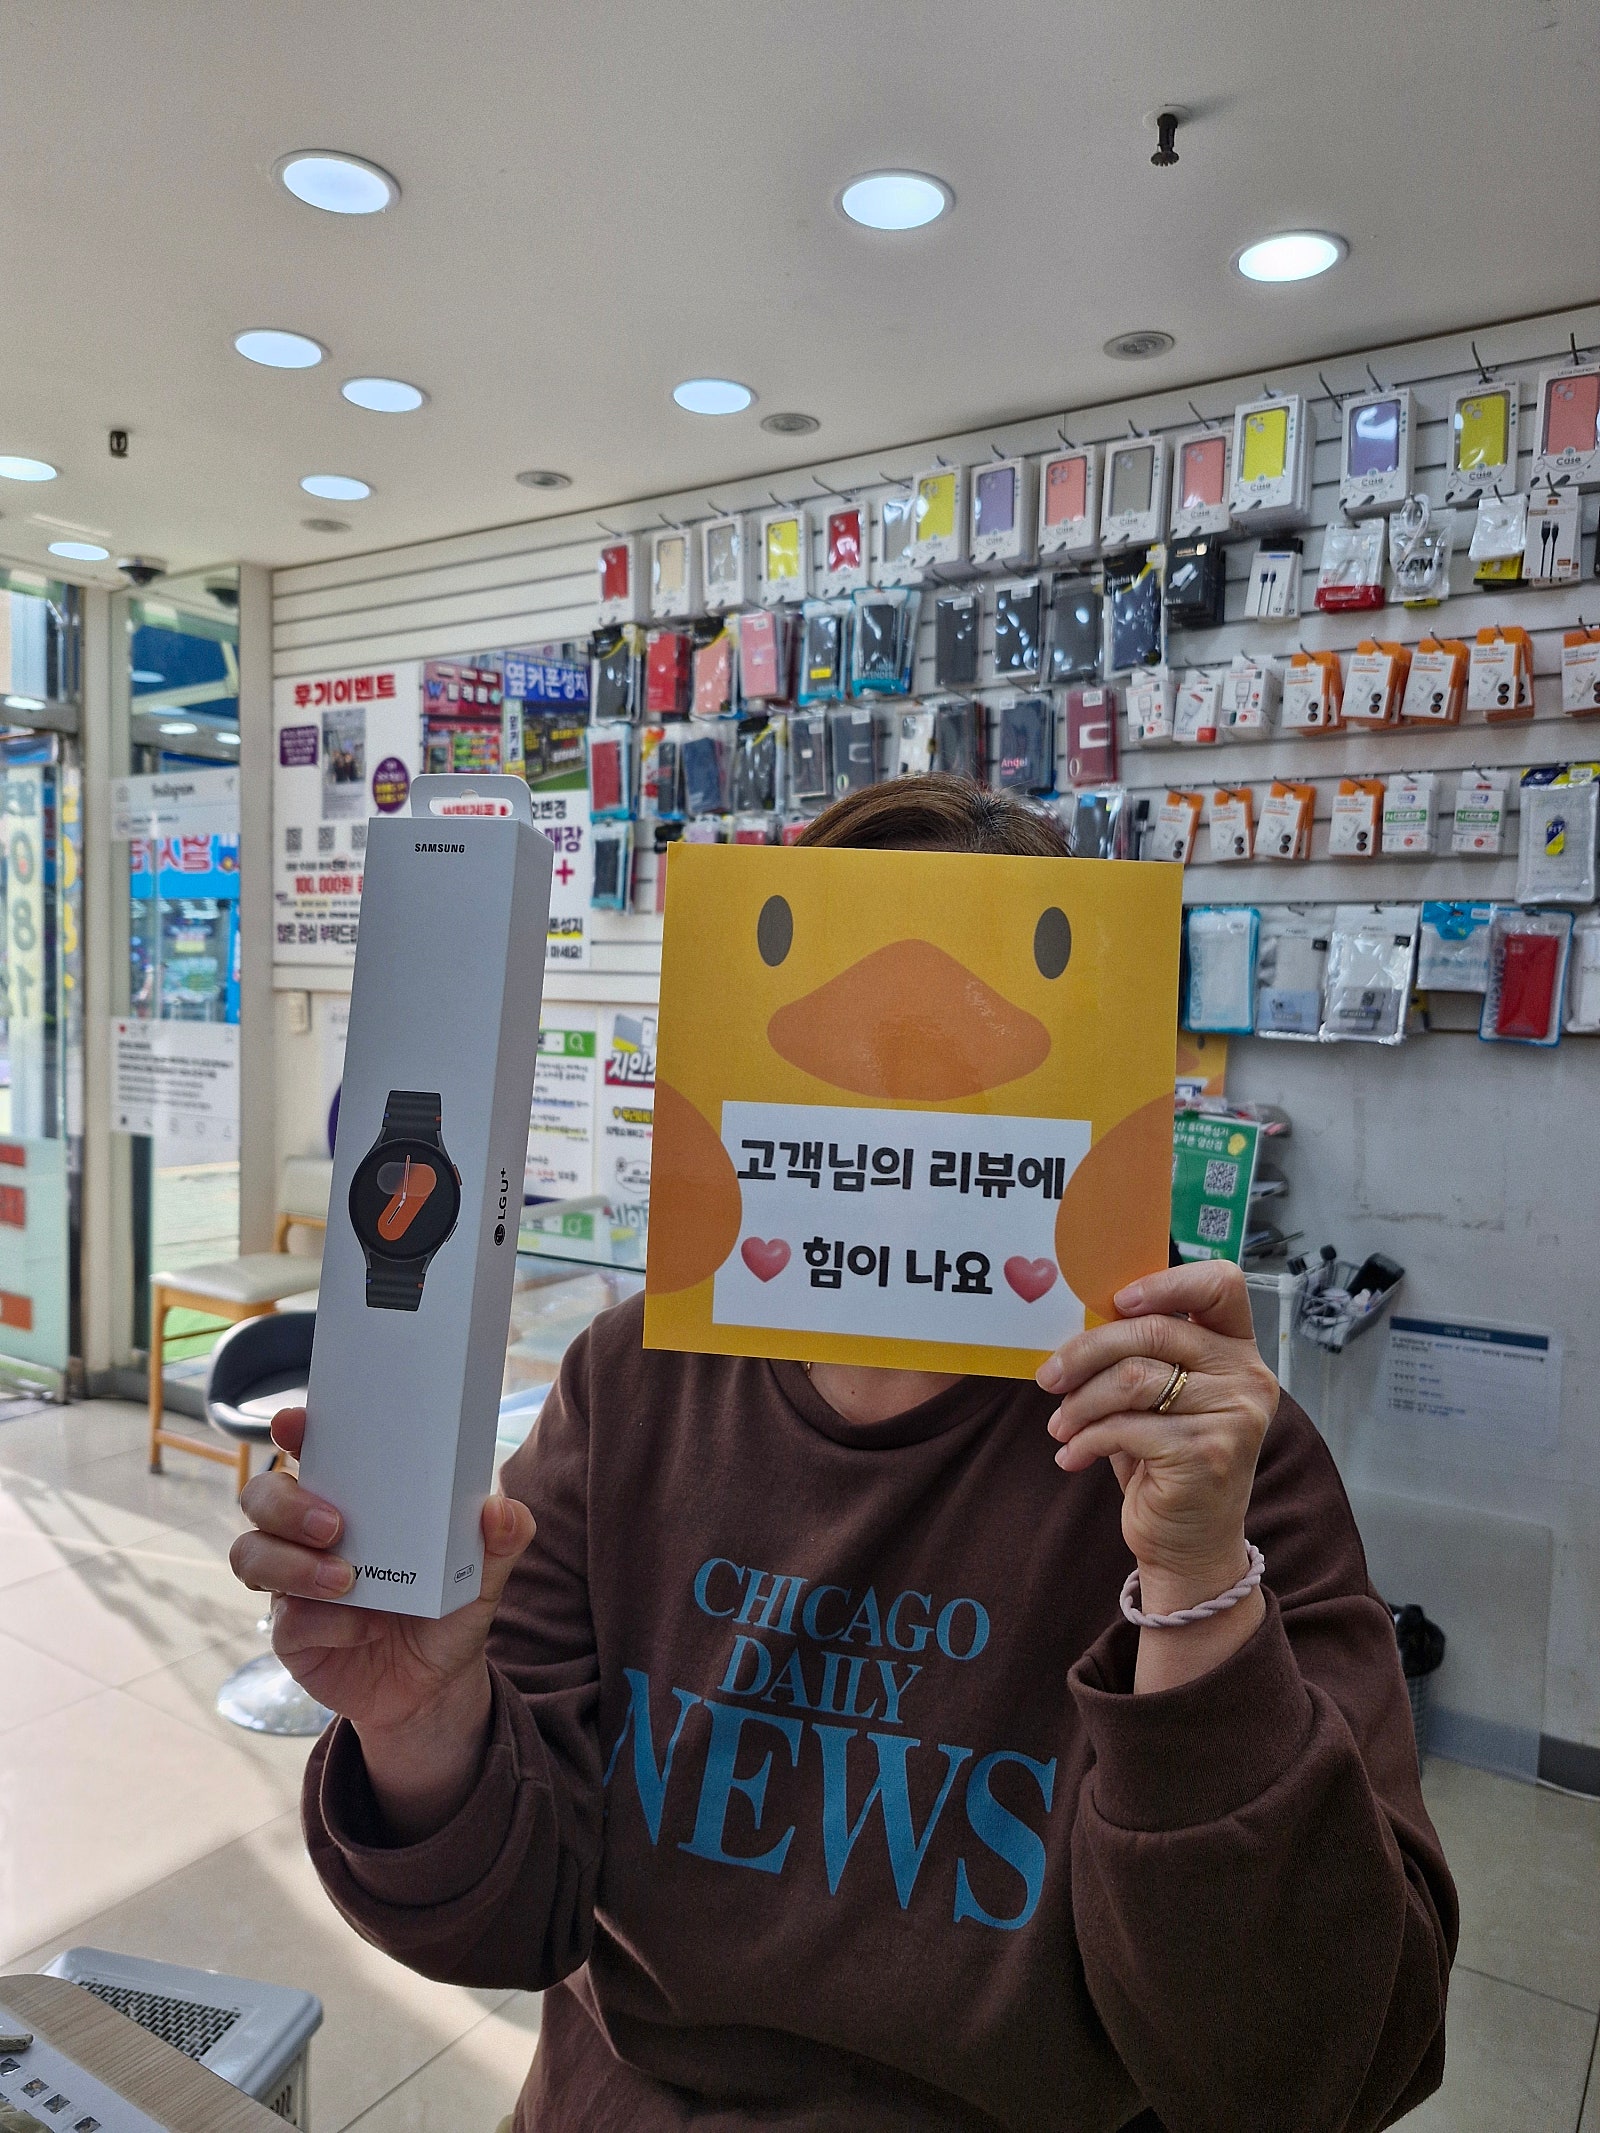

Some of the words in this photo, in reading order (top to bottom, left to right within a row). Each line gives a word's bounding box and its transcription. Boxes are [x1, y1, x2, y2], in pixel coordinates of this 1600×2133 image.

[1469, 471, 1492, 481] Case
[1556, 456, 1581, 466] Case
[294, 674, 396, 708] 후기이벤트
[414, 843, 465, 853] SAMSUNG
[737, 1139, 914, 1192] 고객님의
[930, 1150, 1066, 1200] 리뷰에
[803, 1236, 890, 1289] 힘이
[906, 1249, 993, 1295] 나요
[364, 1564, 417, 1585] Watch7
[694, 1557, 990, 1661] CHICAGO
[717, 1634, 923, 1723] DAILY
[603, 1667, 1057, 1930] NEWS
